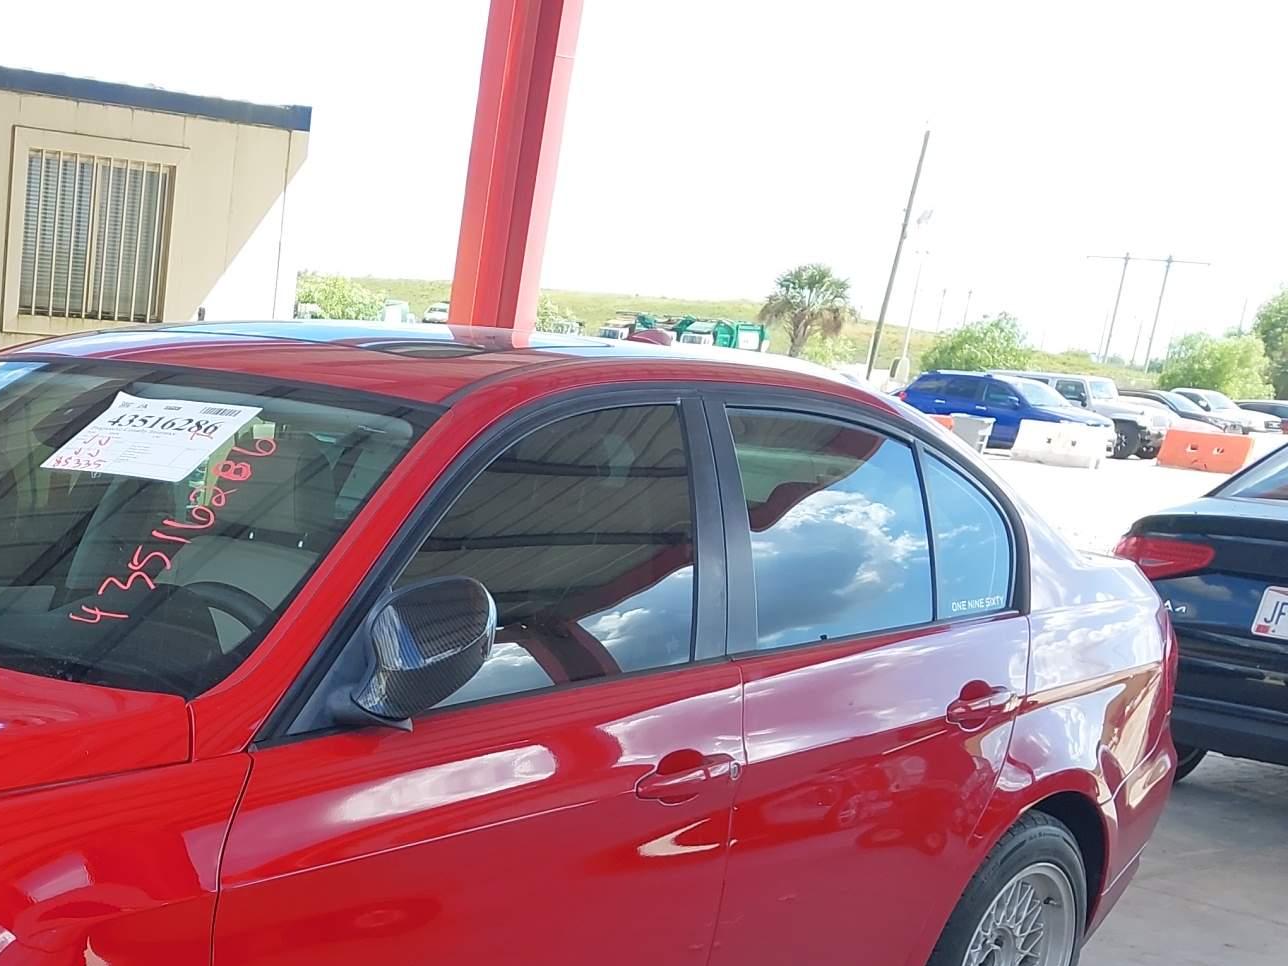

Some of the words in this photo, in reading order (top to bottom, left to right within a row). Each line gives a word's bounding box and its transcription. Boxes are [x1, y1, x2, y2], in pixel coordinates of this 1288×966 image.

[108, 413, 225, 436] 43516286
[952, 600, 967, 612] ONE
[968, 598, 985, 609] NINE
[985, 595, 1004, 607] SIXTY
